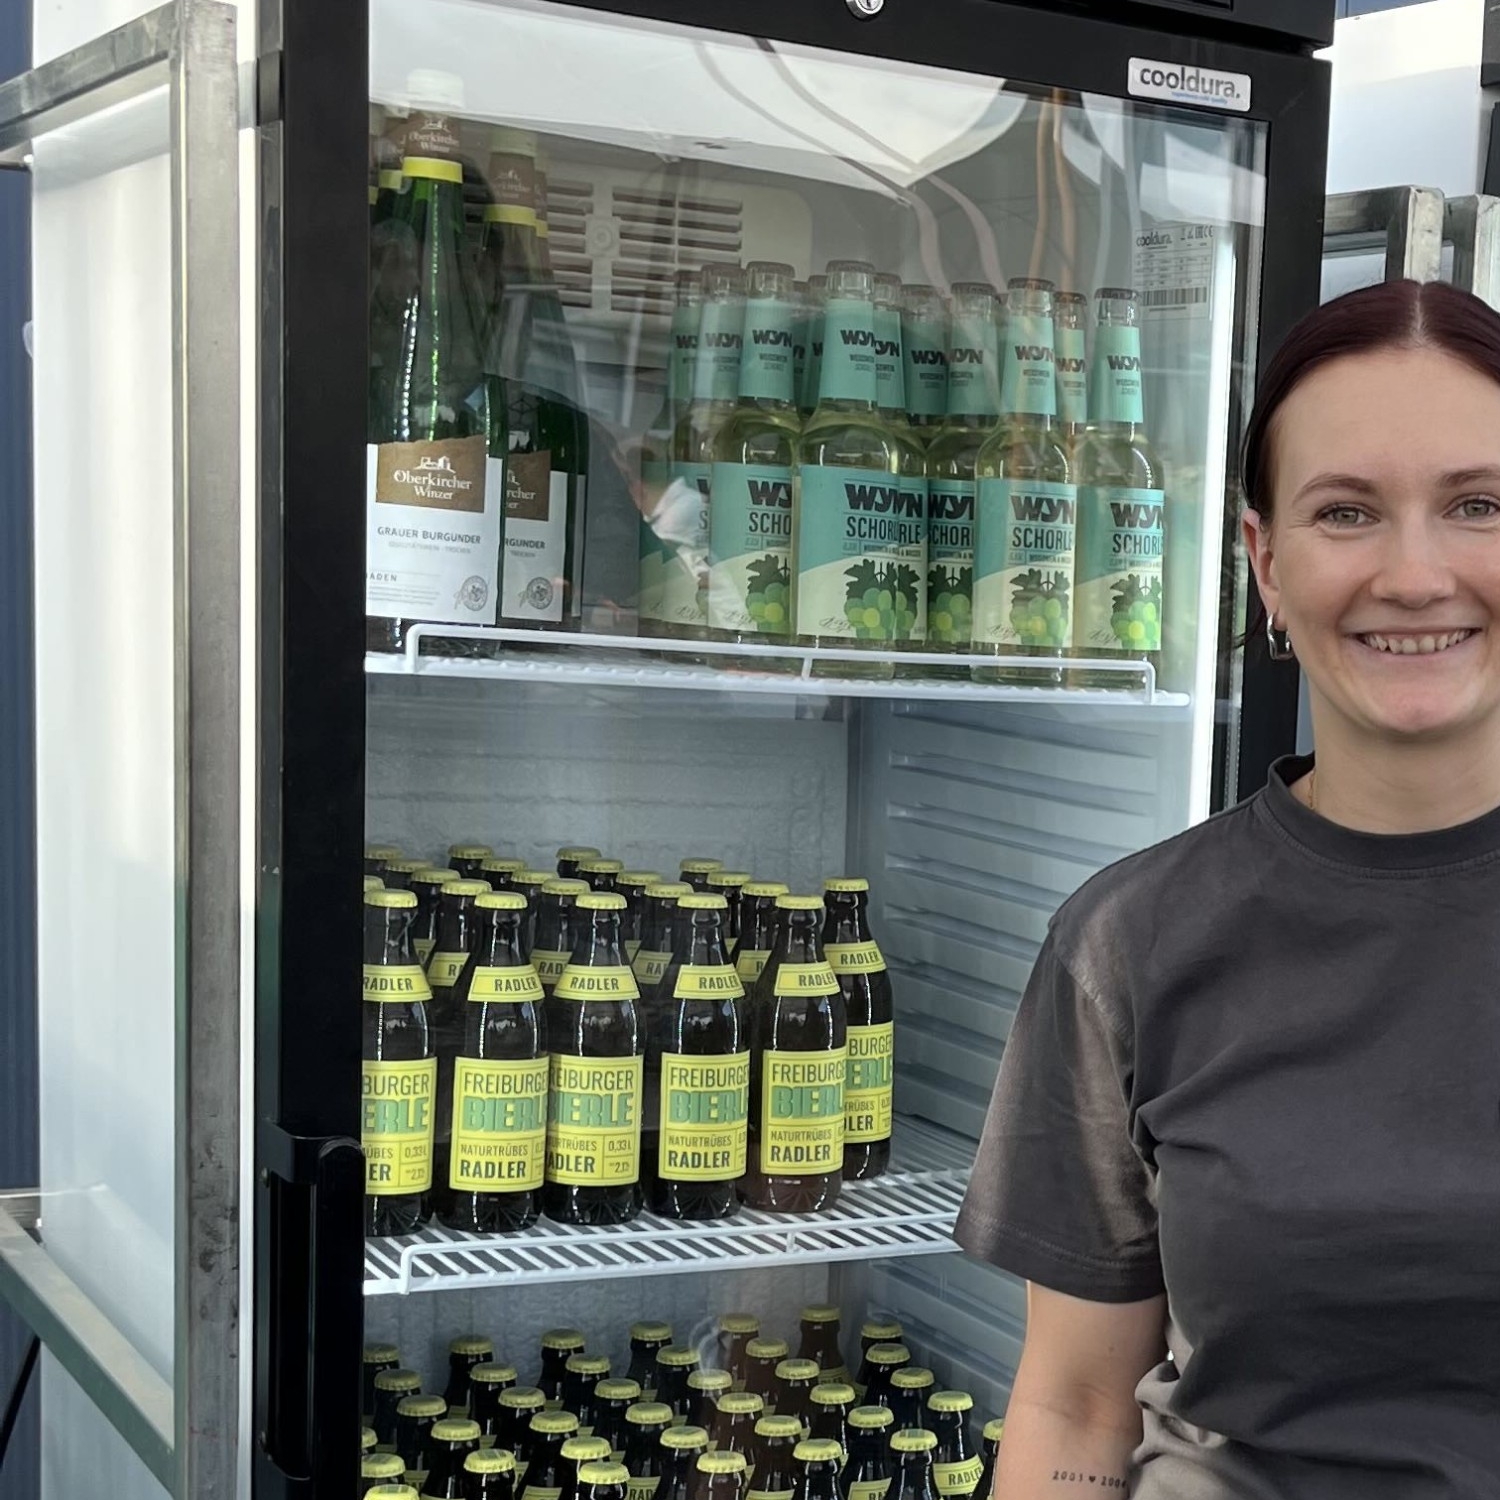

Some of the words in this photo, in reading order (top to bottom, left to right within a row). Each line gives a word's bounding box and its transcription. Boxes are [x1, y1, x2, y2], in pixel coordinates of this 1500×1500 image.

[1140, 67, 1241, 99] cooldura.
[752, 330, 792, 349] WYN
[393, 470, 473, 489] Oberkircher
[414, 485, 453, 500] Winzer
[1010, 496, 1074, 525] WYN
[748, 511, 792, 536] SCHO
[377, 526, 418, 539] GRAUER
[422, 530, 481, 544] BURGUNDER
[505, 538, 545, 550] RGUNDER
[367, 572, 397, 582] ADEN
[840, 950, 879, 965] RADLER
[539, 961, 562, 975] RAD
[495, 977, 538, 992] RADLER
[570, 976, 619, 991] RADLER
[699, 974, 738, 989] RADLER
[849, 1034, 892, 1056] BURGE
[362, 1073, 429, 1096] BURGER
[464, 1072, 548, 1096] FREIBURGE
[551, 1066, 634, 1091] REIBURGER
[670, 1066, 749, 1088] FREIBURGE
[669, 1086, 749, 1124] BIERL
[771, 1083, 845, 1120] BIERL
[362, 1097, 430, 1134] ERLE
[462, 1095, 548, 1132] BIERL
[845, 1114, 874, 1131] LER
[668, 1133, 732, 1148] NATURTRÜBES
[770, 1129, 832, 1142] NATURTRÜBES
[460, 1143, 528, 1157] NATURTRÜBES
[668, 1150, 730, 1169] RADLER
[770, 1144, 831, 1162] RADLER
[460, 1160, 526, 1179] RADLER
[549, 1152, 595, 1173] ADLER
[629, 1489, 655, 1500] RAD
